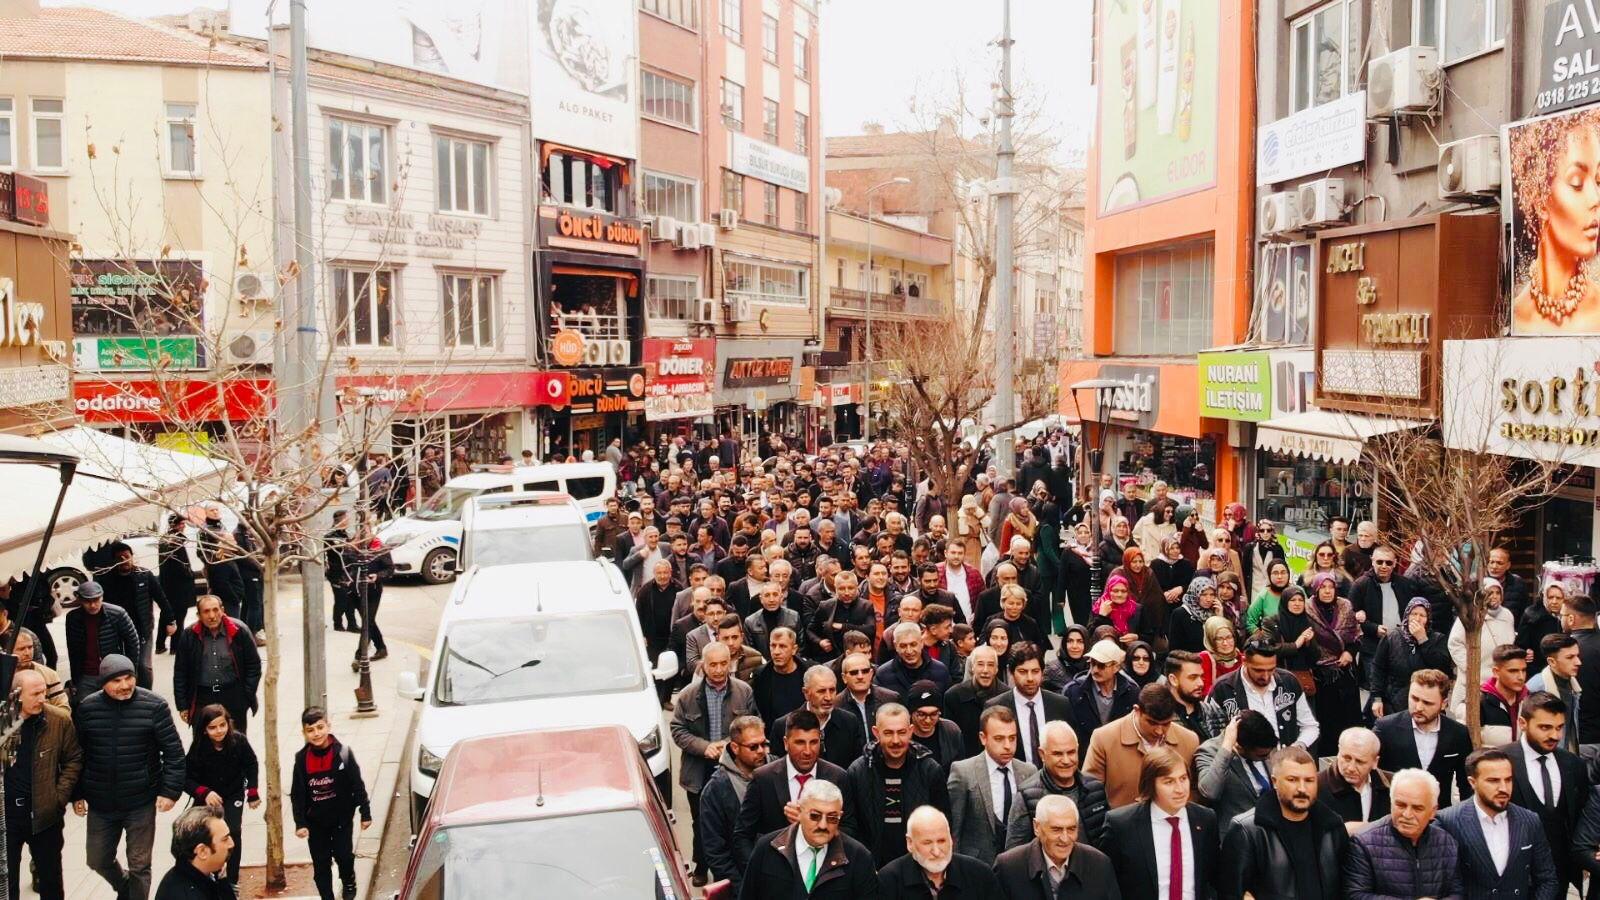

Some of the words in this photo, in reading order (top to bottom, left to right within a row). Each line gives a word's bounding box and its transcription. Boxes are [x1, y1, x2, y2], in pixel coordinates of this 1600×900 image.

[1537, 86, 1565, 109] 0318
[1567, 80, 1589, 101] 225
[583, 107, 613, 123] PAKET
[560, 210, 603, 239] ÖNCÜ
[659, 355, 704, 376] DÖNER
[1207, 361, 1259, 384] NURANİ
[570, 374, 602, 397] ÖNCÜ
[1206, 386, 1263, 415] İLETİŞİM
